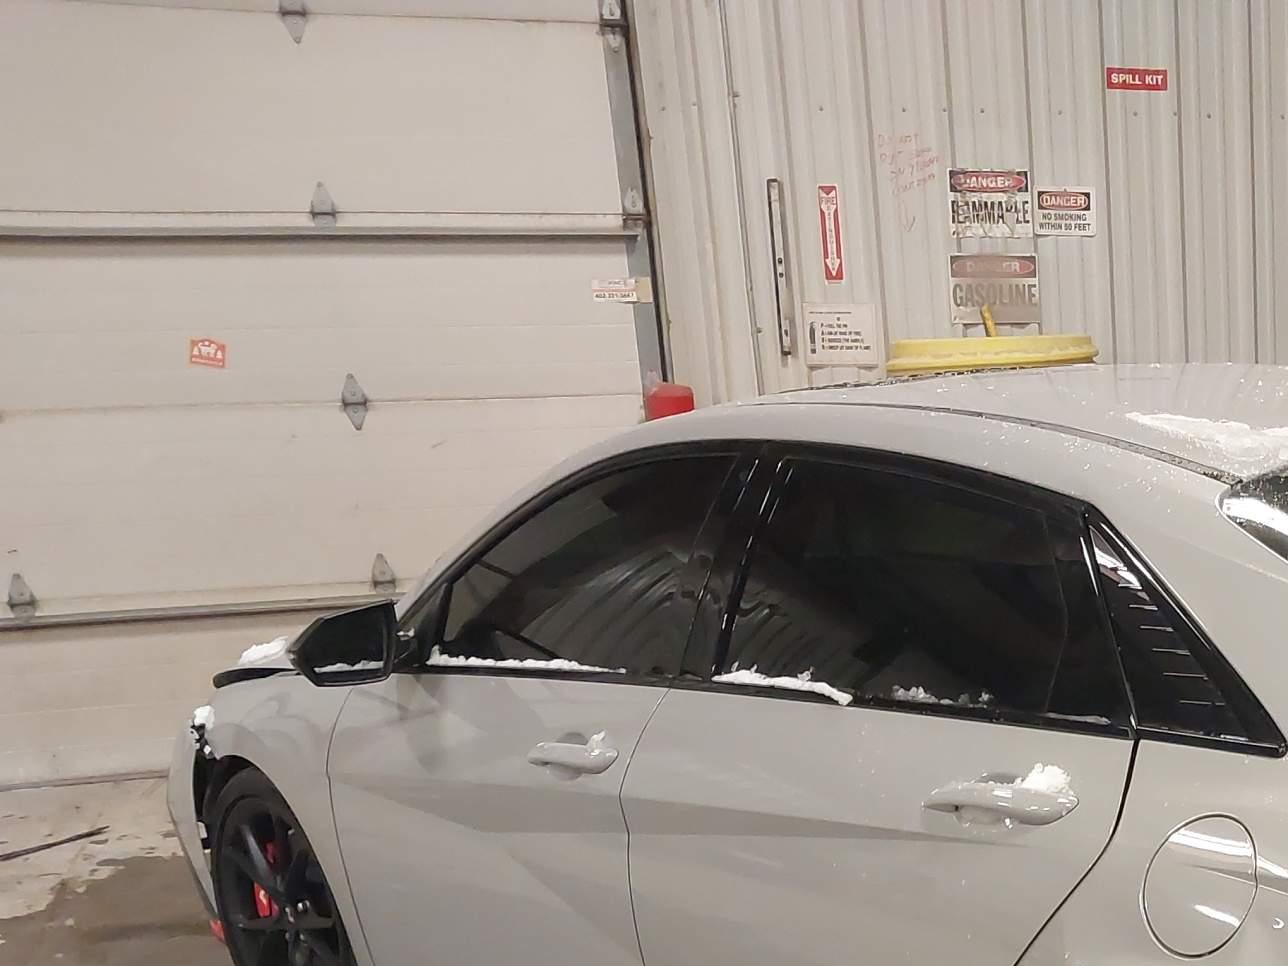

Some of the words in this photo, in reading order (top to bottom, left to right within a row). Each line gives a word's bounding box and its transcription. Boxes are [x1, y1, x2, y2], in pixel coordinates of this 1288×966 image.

[1111, 73, 1142, 84] SPILL
[1145, 75, 1163, 85] KIT
[1043, 195, 1084, 206] DANGER
[1042, 213, 1052, 221] NO
[1054, 213, 1087, 222] SMOKING
[1039, 223, 1062, 231] WITHIN
[1074, 223, 1091, 231] FEET
[965, 261, 1020, 272] DER
[952, 284, 1037, 307] GASOLINE
